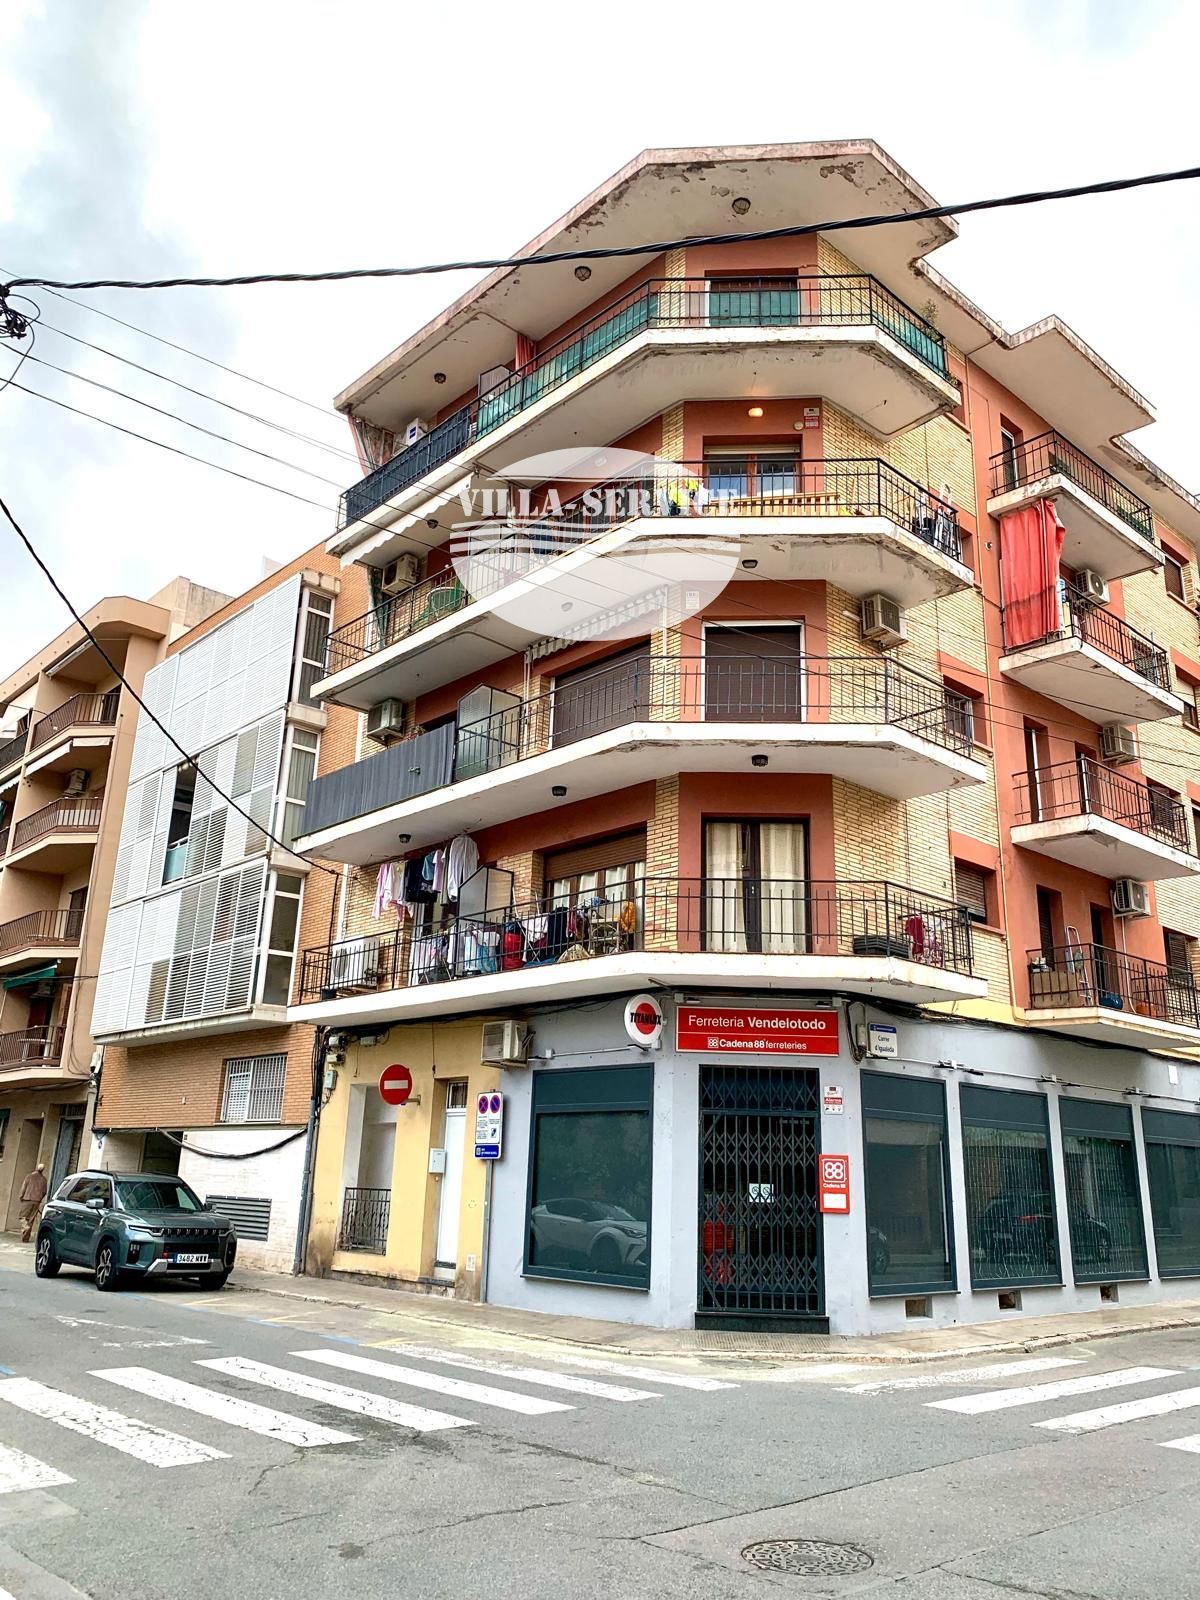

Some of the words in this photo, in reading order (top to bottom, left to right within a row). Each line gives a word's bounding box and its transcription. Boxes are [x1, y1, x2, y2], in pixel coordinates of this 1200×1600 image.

[688, 1015, 744, 1028] Ferreteria
[748, 1016, 826, 1030] Vendelotodo
[719, 1038, 753, 1048] Cadena
[754, 1040, 765, 1049] 88
[765, 1040, 807, 1050] ferreteries
